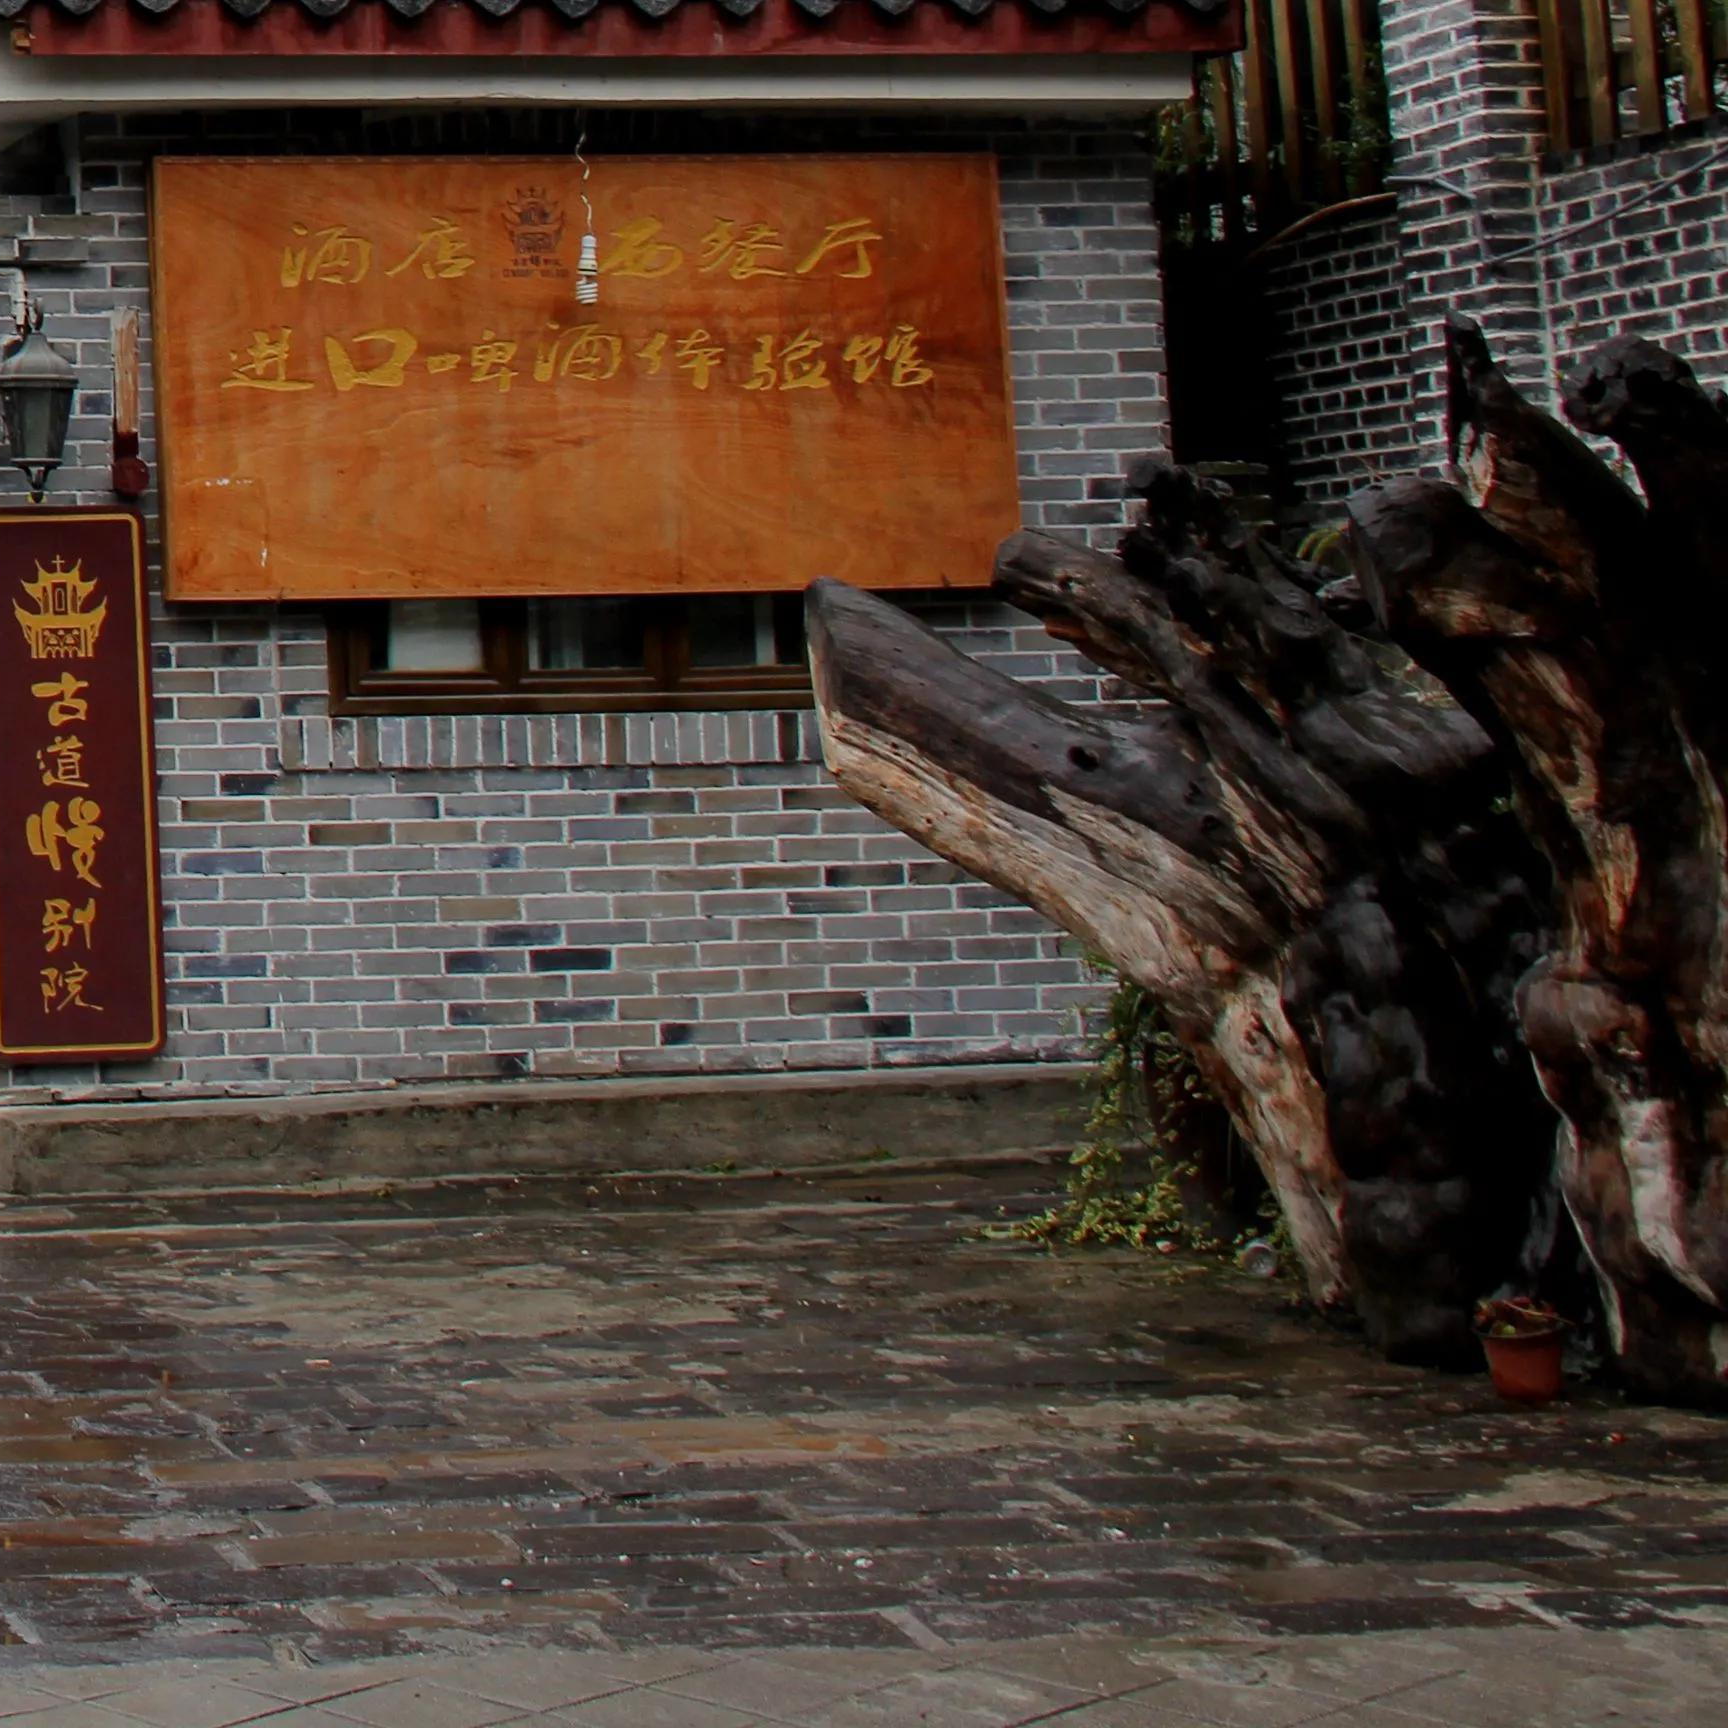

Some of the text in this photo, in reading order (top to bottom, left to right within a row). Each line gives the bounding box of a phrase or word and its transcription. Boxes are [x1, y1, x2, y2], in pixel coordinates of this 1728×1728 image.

[280, 216, 884, 288] 酒店 西餐厅
[220, 322, 936, 392] 进口啤酒体验馆
[26, 672, 106, 1013] 古道慢别院
